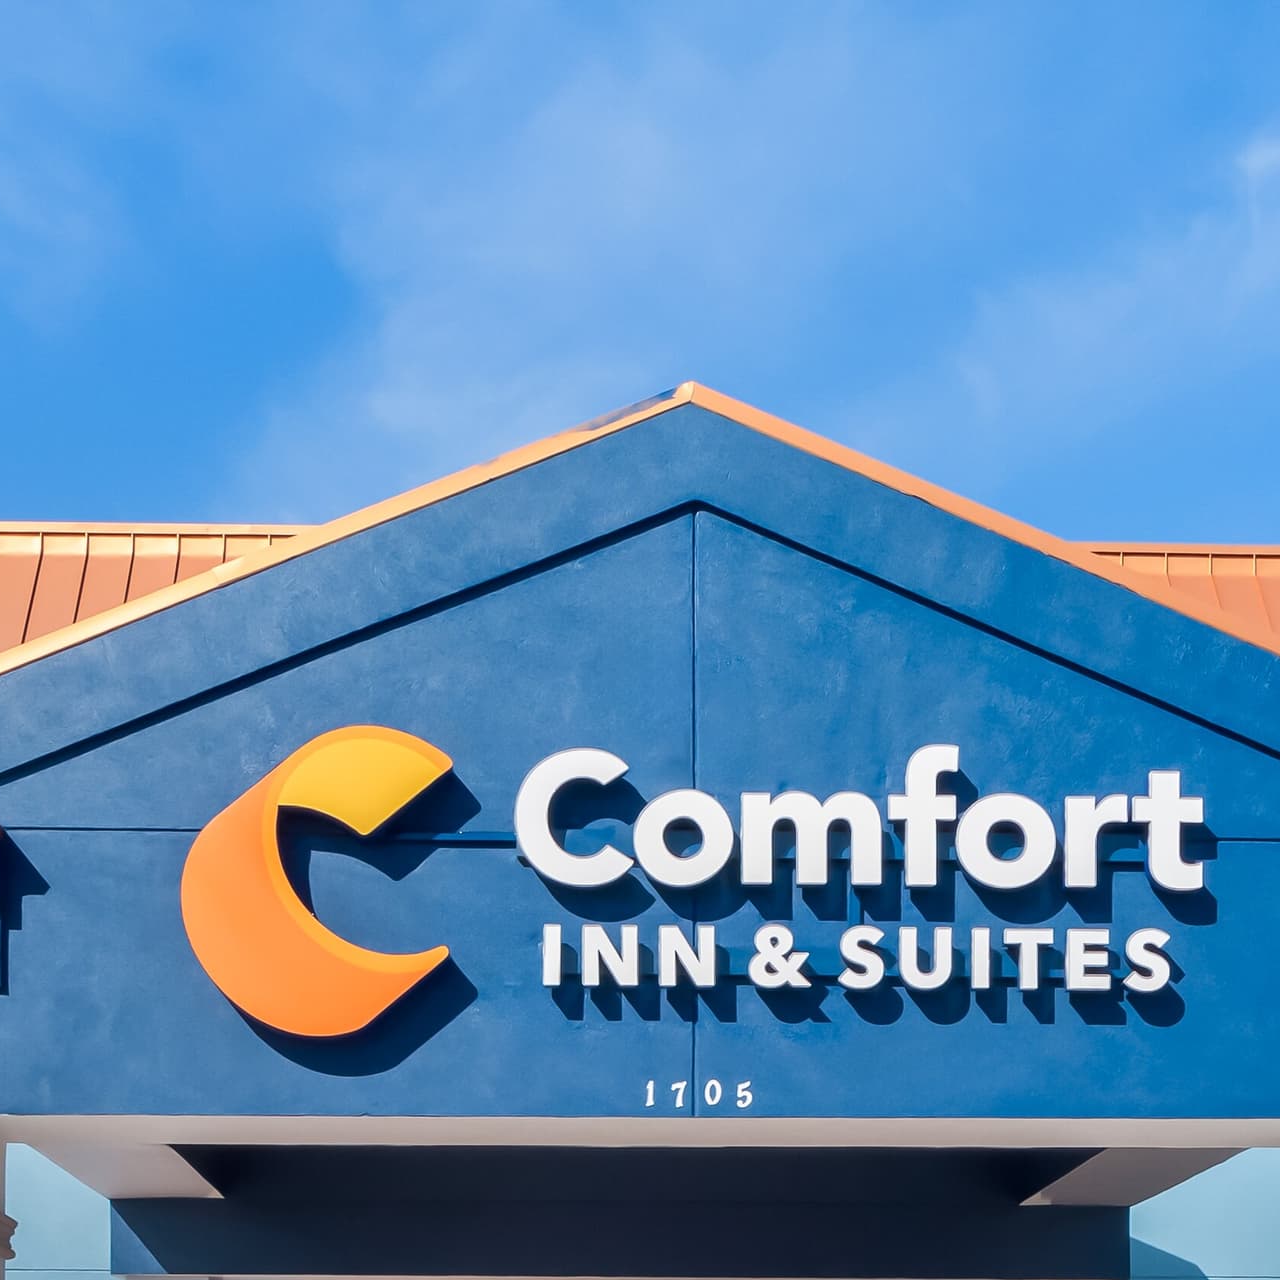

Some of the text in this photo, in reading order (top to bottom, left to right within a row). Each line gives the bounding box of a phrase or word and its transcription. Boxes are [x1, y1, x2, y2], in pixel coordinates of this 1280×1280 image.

[514, 744, 1204, 891] Comfort
[542, 923, 1172, 992] INN & SUITES
[645, 1079, 753, 1108] 1705
